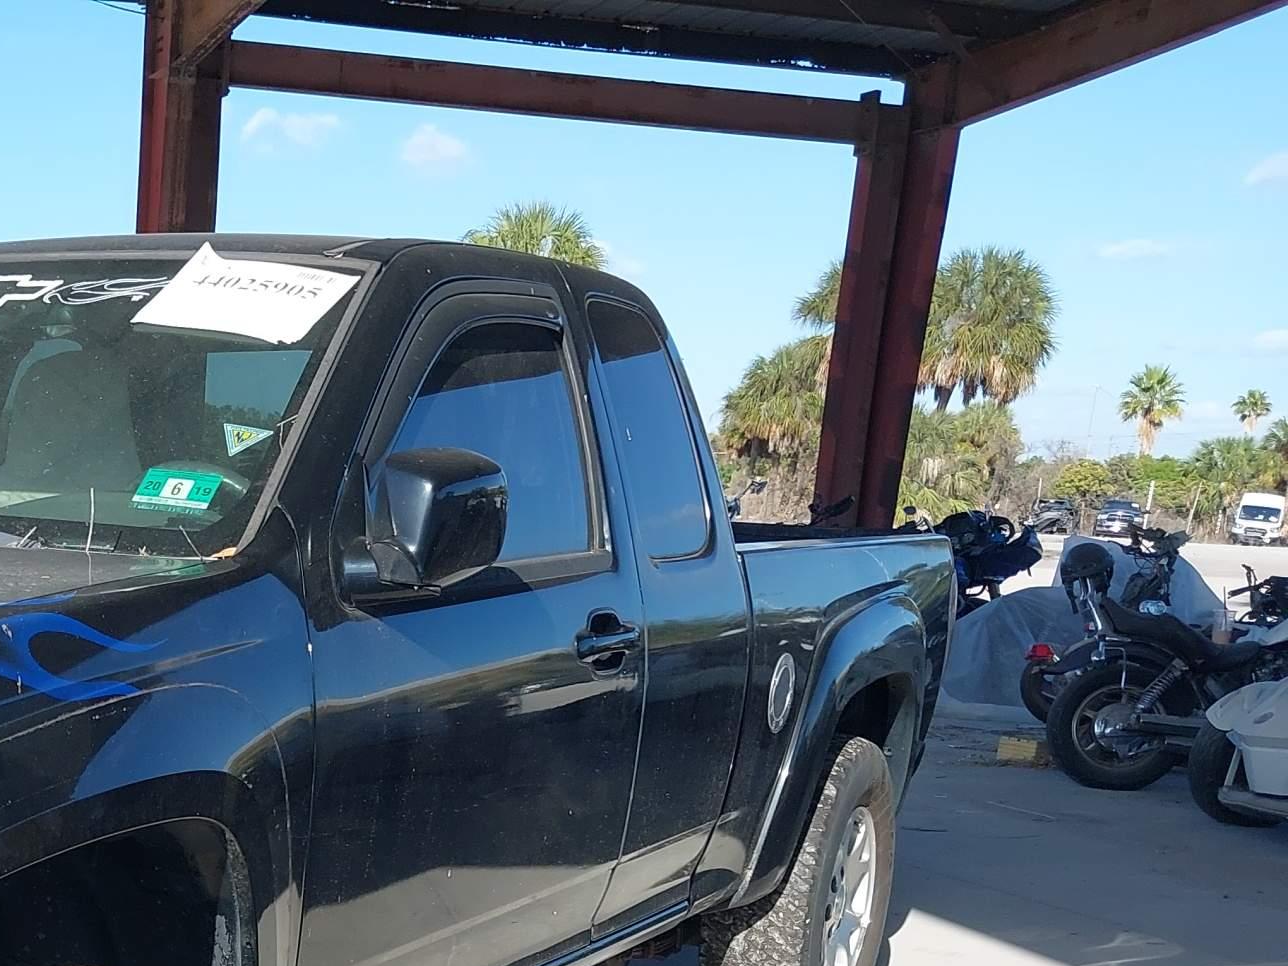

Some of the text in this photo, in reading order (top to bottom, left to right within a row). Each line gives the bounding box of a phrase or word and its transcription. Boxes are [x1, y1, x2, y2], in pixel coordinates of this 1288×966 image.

[192, 273, 323, 300] 44025905
[144, 480, 212, 497] 20 6 19
